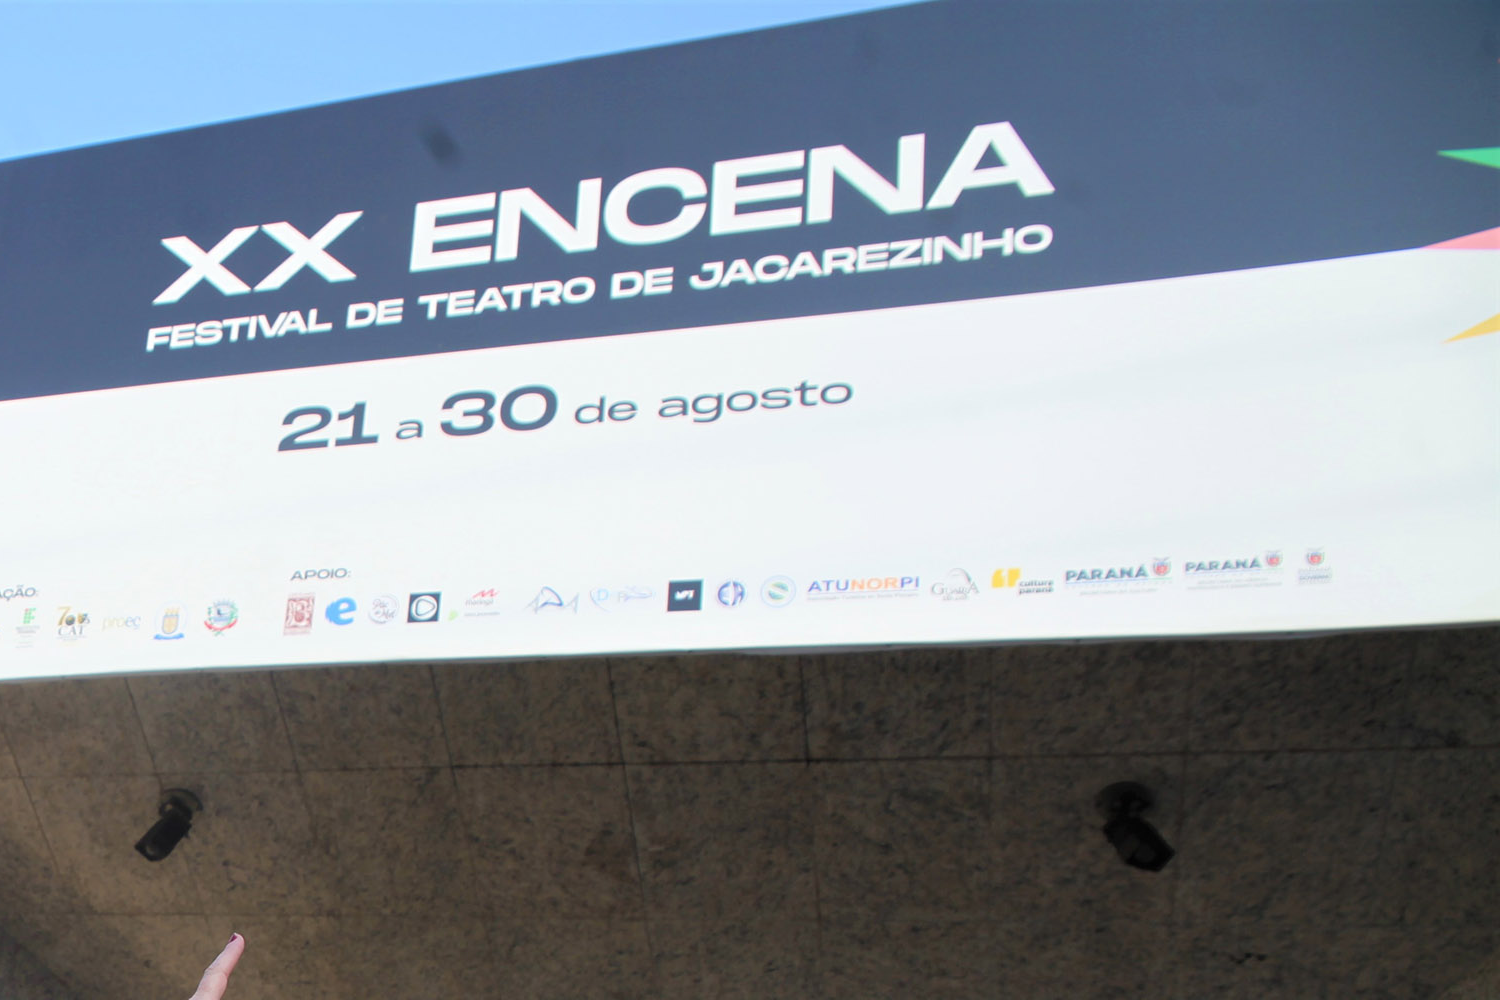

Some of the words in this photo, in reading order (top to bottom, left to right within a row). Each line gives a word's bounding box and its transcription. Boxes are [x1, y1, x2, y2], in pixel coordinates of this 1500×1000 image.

[152, 210, 363, 305] XX
[408, 121, 1056, 273] ENCENA
[144, 306, 333, 352] FESTIVAL
[345, 298, 404, 330] DE
[417, 277, 596, 320] TEATRO
[610, 267, 674, 299] DE
[689, 224, 1054, 290] JACAREZINHO
[277, 401, 379, 453] 21
[394, 414, 424, 441] a
[439, 384, 559, 439] 30
[574, 394, 638, 425] de
[657, 379, 854, 424] agosto
[807, 575, 921, 593] ATUNORPI
